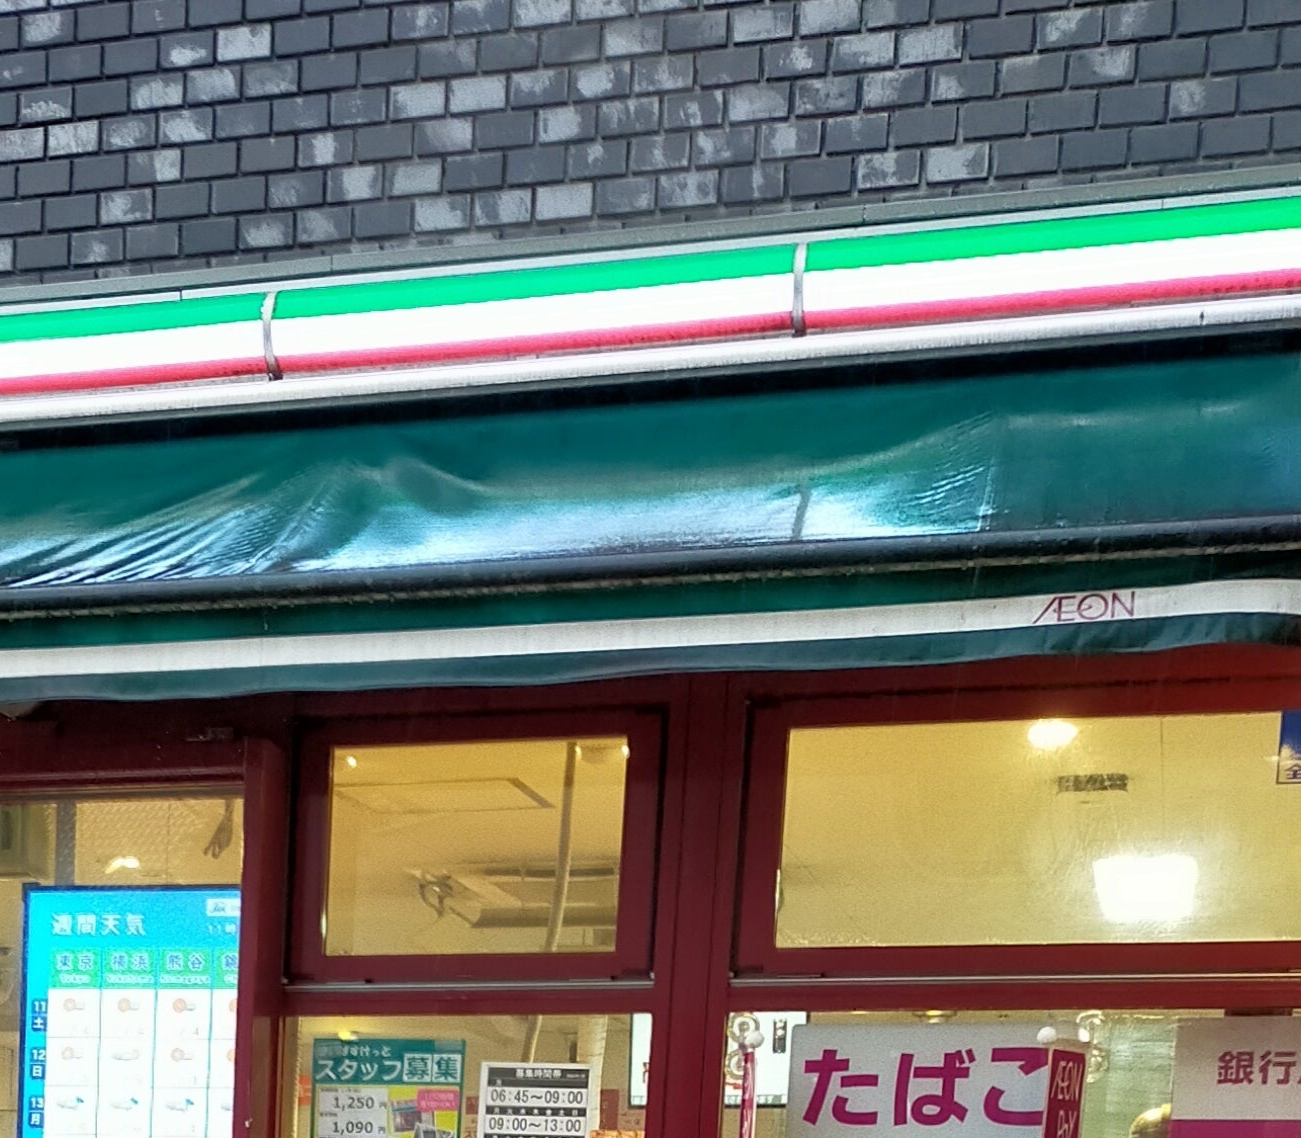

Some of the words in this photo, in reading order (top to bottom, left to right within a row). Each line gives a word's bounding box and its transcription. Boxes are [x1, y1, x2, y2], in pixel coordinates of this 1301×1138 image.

[52, 913, 146, 936] 週間天気
[56, 953, 94, 971] 東京
[111, 953, 150, 971] 横浜
[166, 953, 204, 971] 熊谷
[33, 1000, 46, 1012] 11
[32, 1049, 46, 1060] 12
[315, 1054, 461, 1082] スタッフ募集
[1217, 1051, 1301, 1085] 銀行
[803, 1048, 1049, 1126] たばこ
[30, 1097, 44, 1109] 13
[333, 1097, 375, 1111] 1,250
[332, 1121, 374, 1135] 1,090
